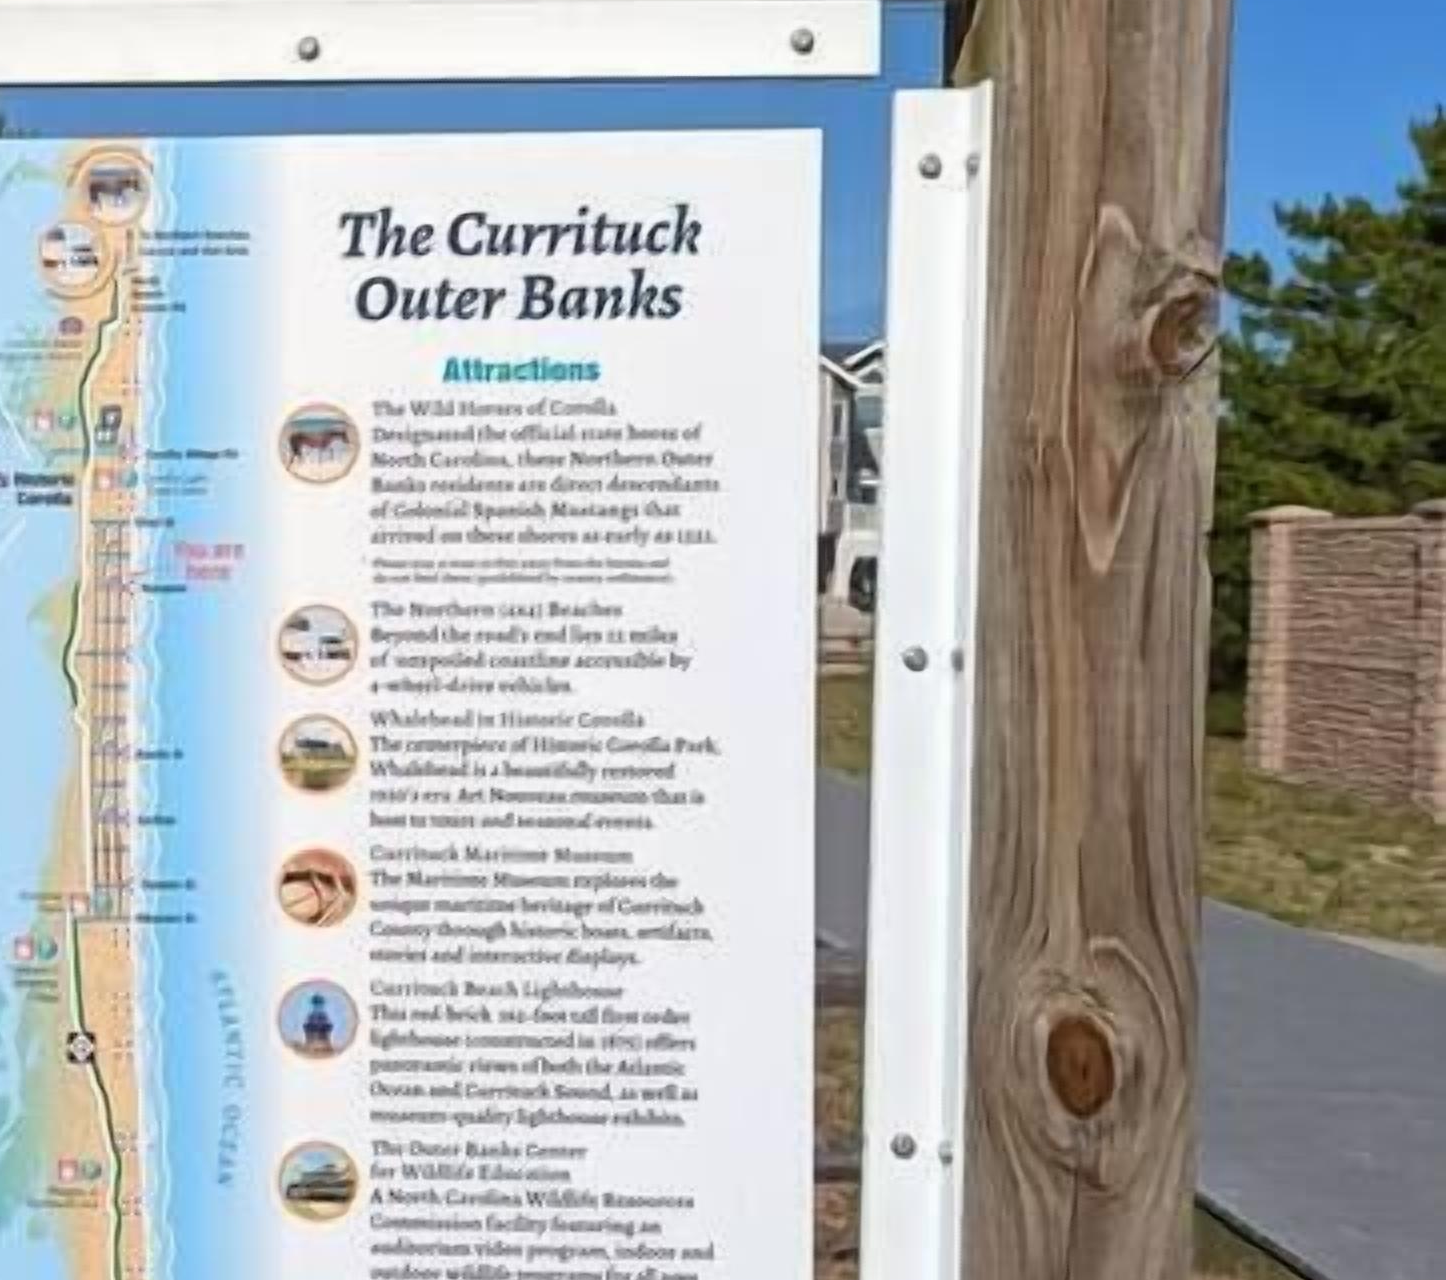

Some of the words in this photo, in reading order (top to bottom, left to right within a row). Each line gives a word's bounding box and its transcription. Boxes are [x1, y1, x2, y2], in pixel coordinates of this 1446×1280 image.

[339, 207, 435, 259] The
[447, 203, 703, 258] Currituck
[355, 275, 506, 322] Outer
[517, 269, 685, 322] Banks
[442, 356, 602, 384] Attractions
[682, 424, 701, 442] of
[370, 501, 390, 519] of
[370, 1188, 383, 1206] A
